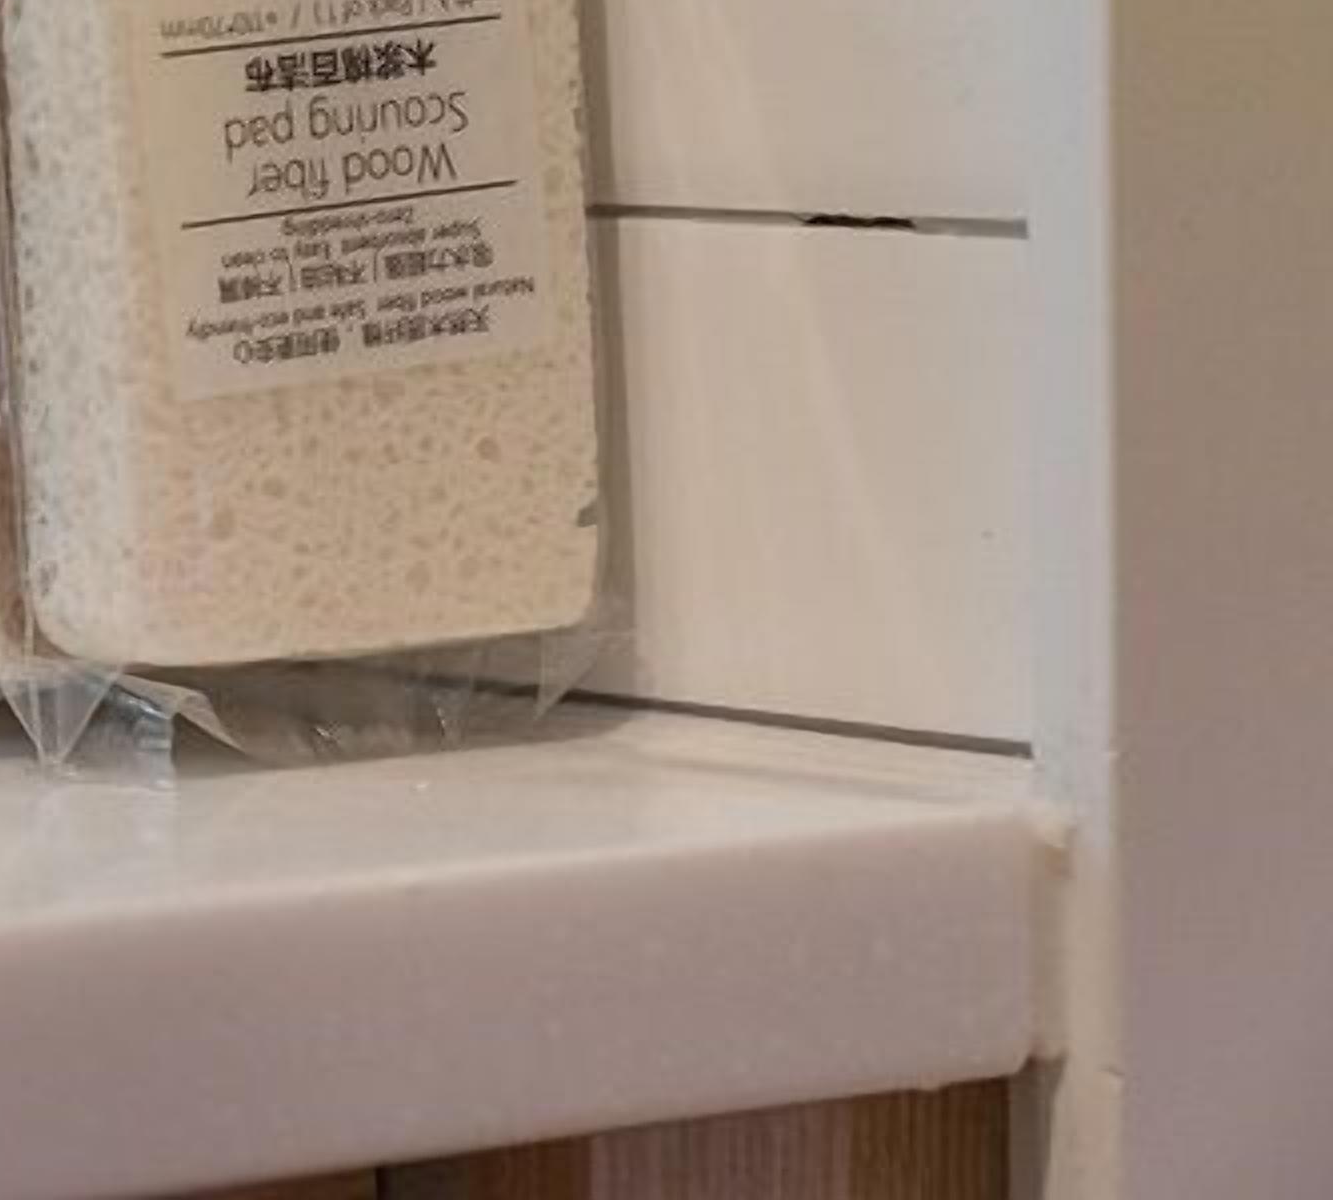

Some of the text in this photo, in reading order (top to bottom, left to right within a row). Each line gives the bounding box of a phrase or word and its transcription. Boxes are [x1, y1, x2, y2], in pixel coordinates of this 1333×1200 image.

[224, 91, 469, 166] Scouring pad
[247, 142, 457, 201] Wood fiber
[420, 289, 467, 309] wood
[472, 276, 535, 300] Natural
[330, 299, 366, 321] Safe
[376, 292, 417, 314] fiber
[292, 306, 325, 328] and
